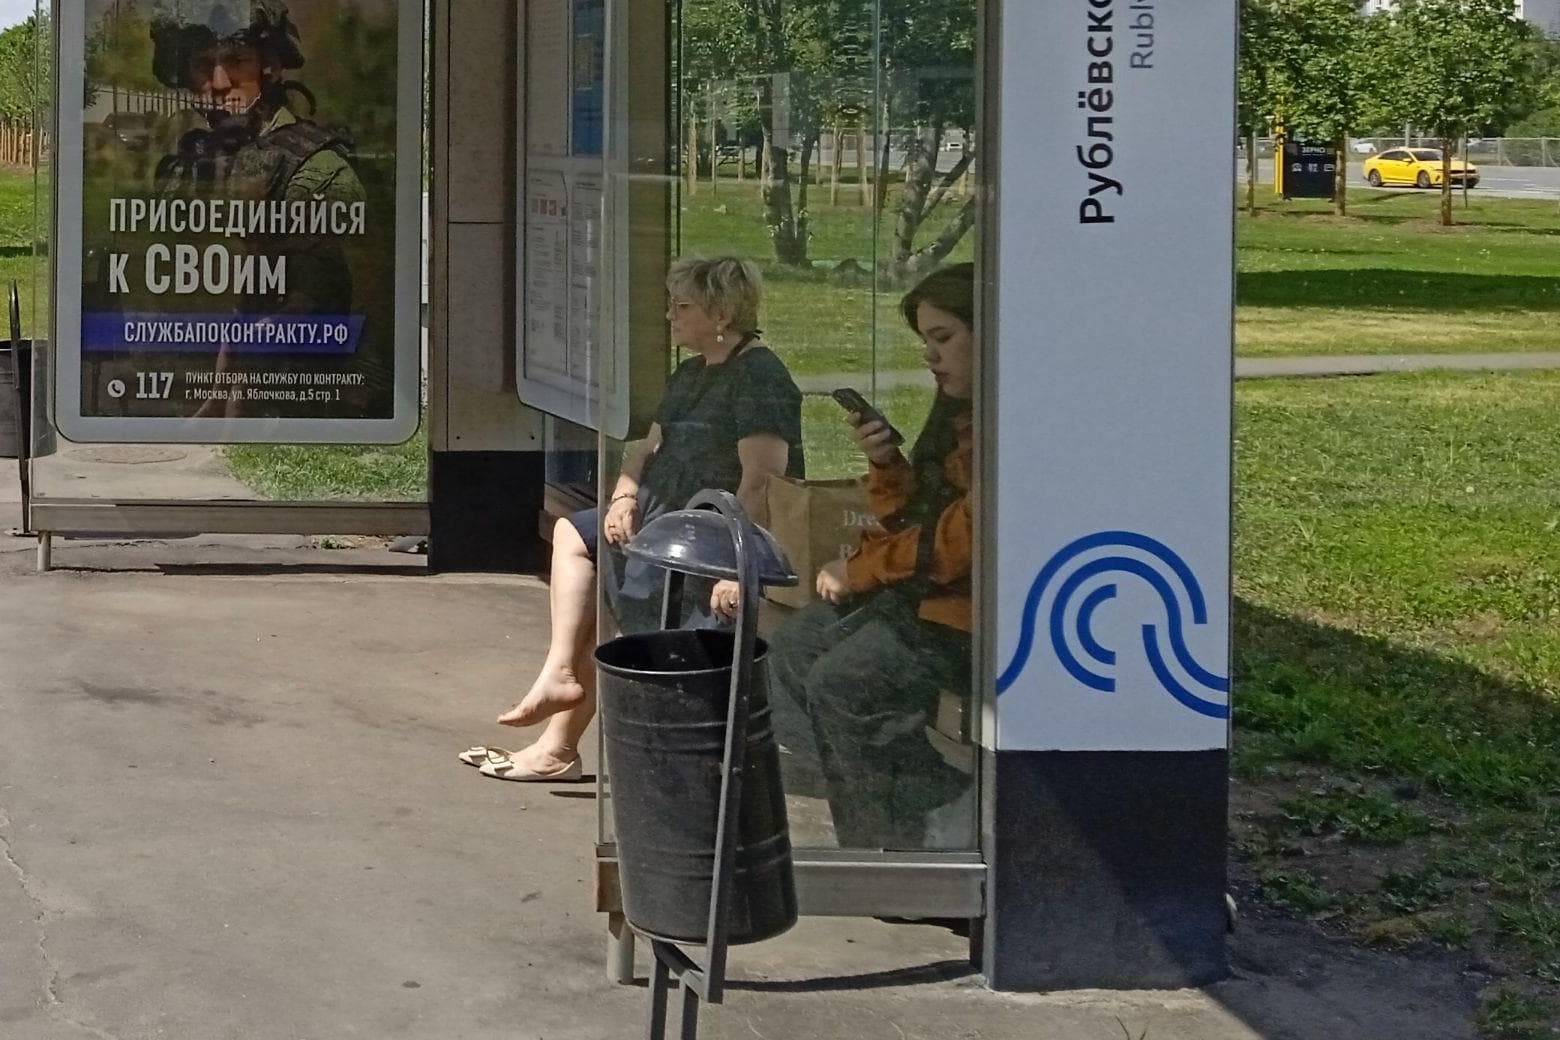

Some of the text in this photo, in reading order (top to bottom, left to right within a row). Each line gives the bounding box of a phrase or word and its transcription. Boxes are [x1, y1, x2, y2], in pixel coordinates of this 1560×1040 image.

[109, 193, 366, 238] ПРИСОЕДИНЯЙСЯ
[124, 321, 349, 345] СЛУЖБАПОКОНТРАКТУ.РФ
[136, 371, 175, 399] 117
[185, 372, 365, 385] ПУНКТ ОТБОРА НА СЛУЖБУ ПО КОНТРАКТУ:
[335, 389, 341, 400] 1
